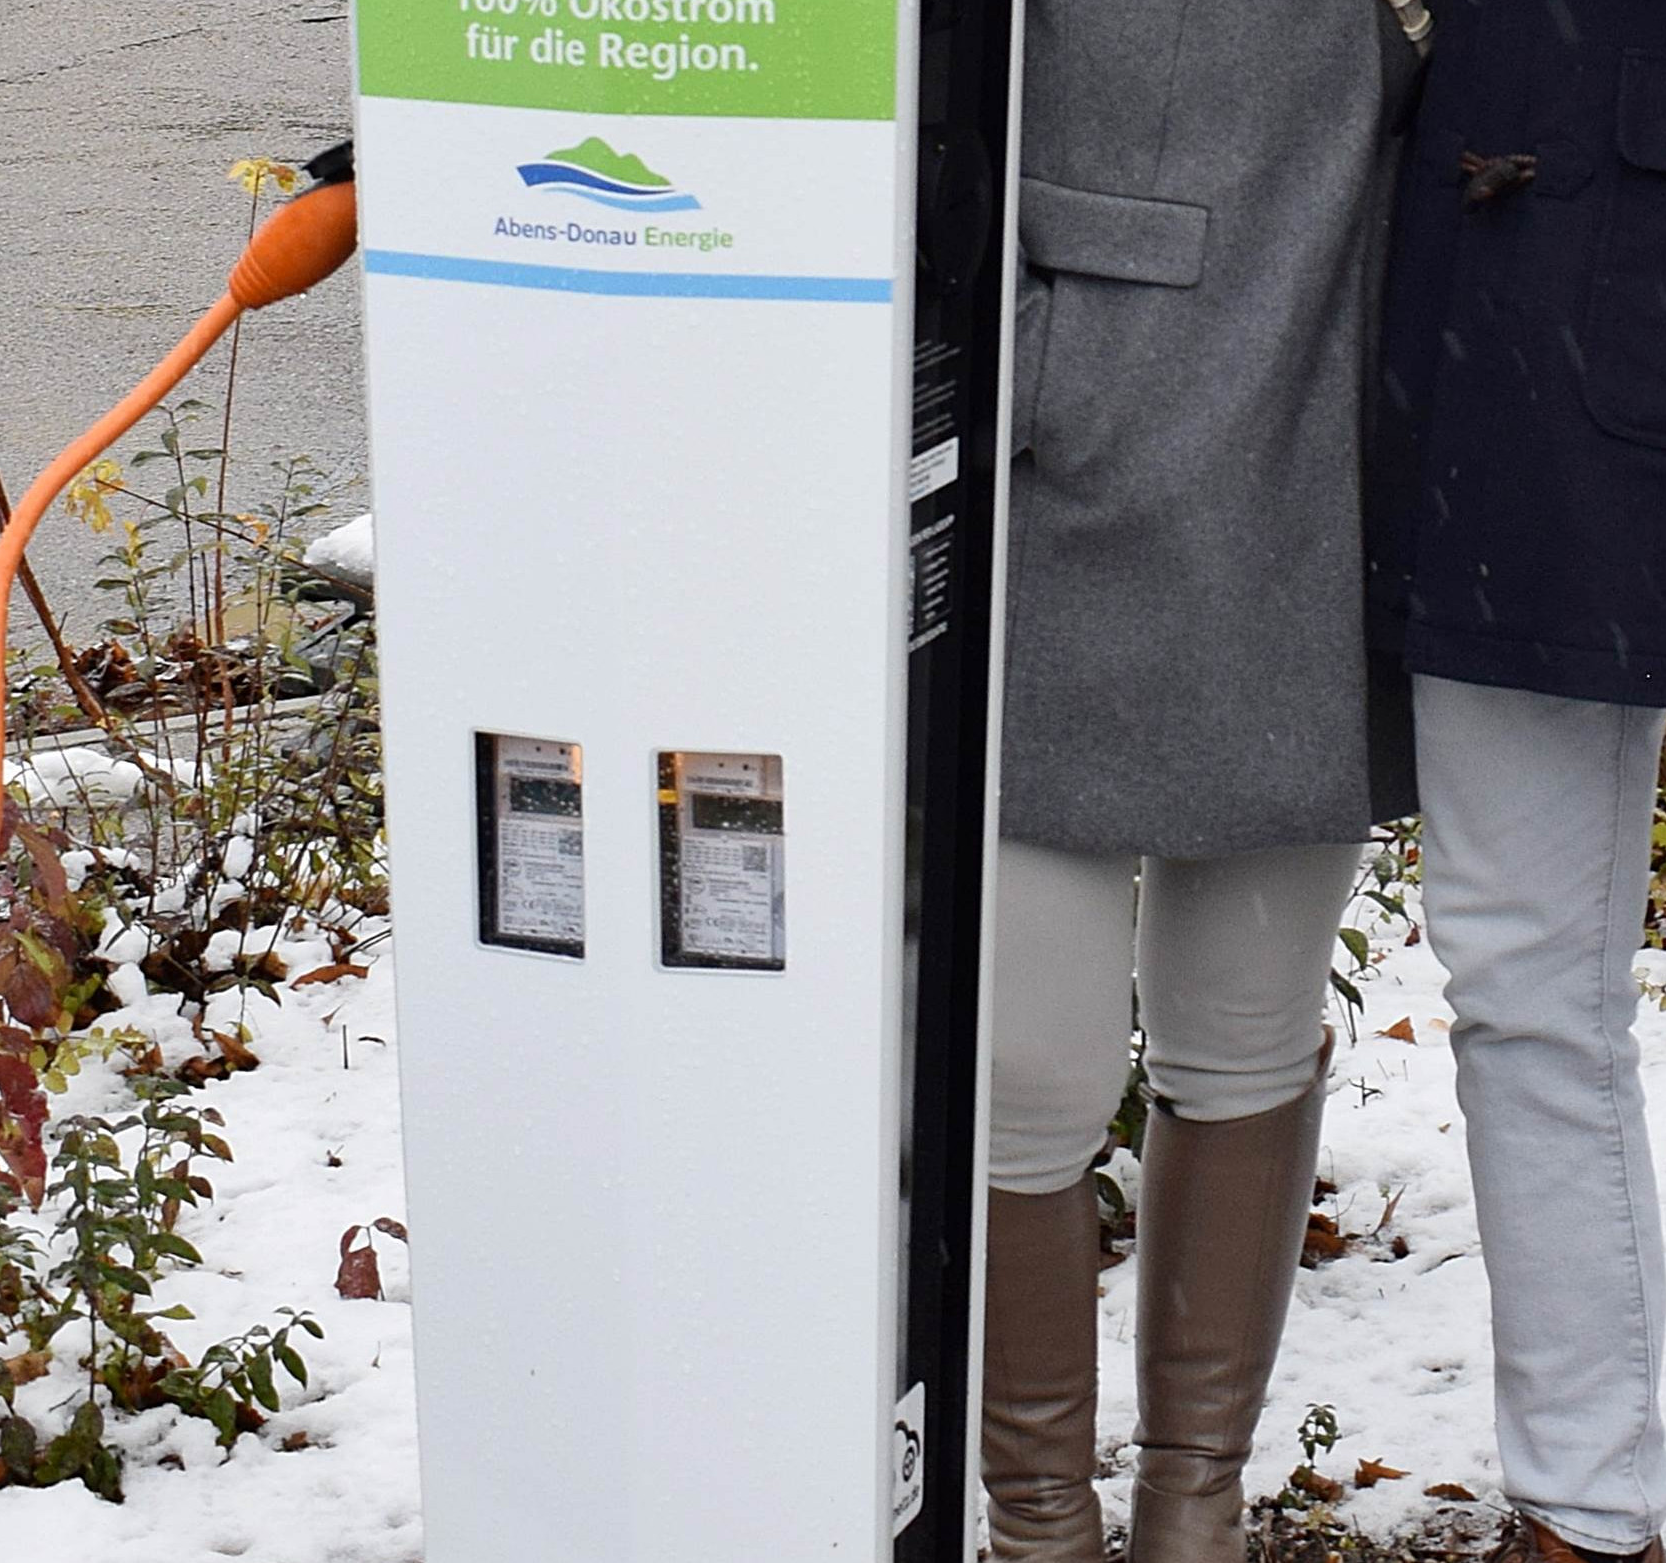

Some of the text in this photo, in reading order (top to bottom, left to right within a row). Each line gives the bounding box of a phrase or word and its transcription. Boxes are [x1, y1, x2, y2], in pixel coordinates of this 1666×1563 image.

[465, 22, 760, 81] für die Region.
[494, 216, 735, 253] Abens-Donau Energie
